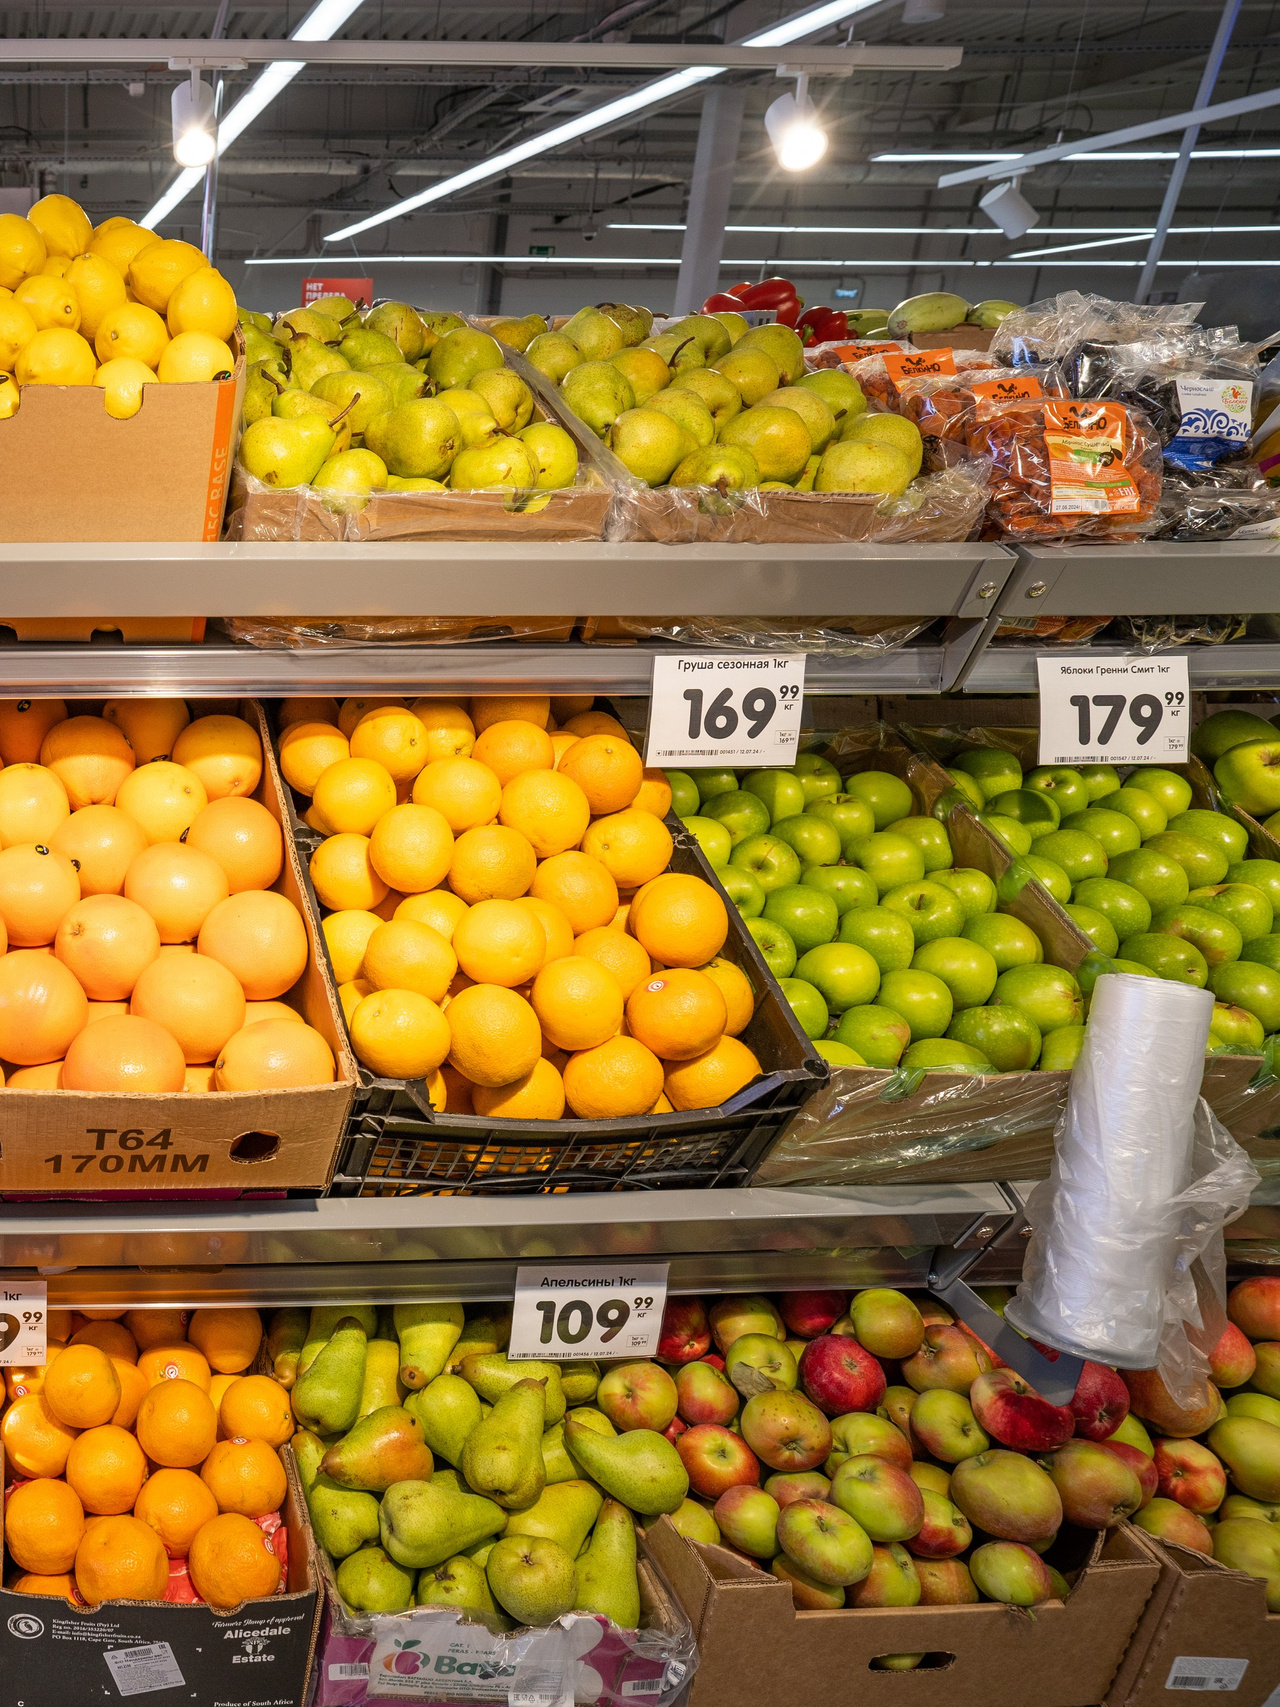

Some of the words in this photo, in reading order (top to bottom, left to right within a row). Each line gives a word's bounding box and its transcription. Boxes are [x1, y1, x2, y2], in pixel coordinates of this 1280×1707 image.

[305, 282, 324, 291] НЕТ
[210, 444, 228, 500] BASE
[678, 659, 714, 672] Груша
[717, 660, 769, 669] сезонная
[772, 658, 789, 669] 1кг
[1060, 666, 1094, 675] Яблоки
[1096, 665, 1129, 676] Гренни
[1131, 665, 1155, 674] Смит
[1157, 665, 1170, 673] 1кг
[683, 687, 777, 740] 169
[779, 684, 800, 699] 99
[784, 703, 794, 711] кг
[1070, 693, 1163, 746] 179
[1164, 691, 1185, 705] 99
[85, 1128, 174, 1151] T64
[43, 1154, 209, 1174] 170MM
[540, 1277, 614, 1288] Апельсины
[619, 1276, 637, 1287] 1кг
[3, 1291, 22, 1301] 1кг
[22, 1311, 43, 1323] 99
[535, 1299, 631, 1344] 109
[634, 1296, 654, 1309] 99
[223, 1626, 291, 1640] Alicedale
[232, 1654, 275, 1664] Estate
